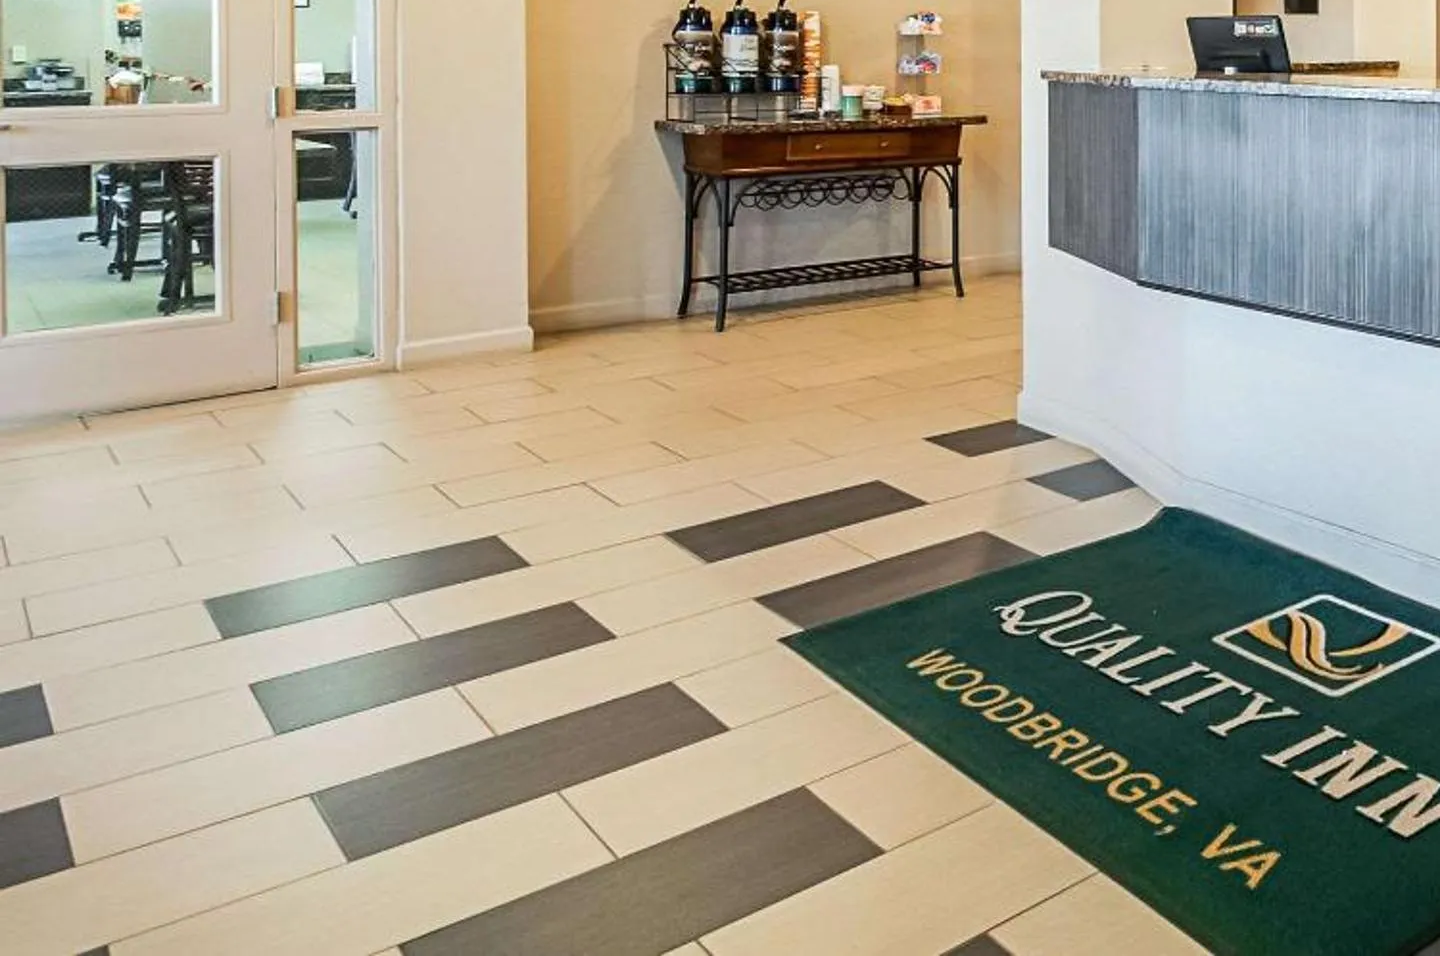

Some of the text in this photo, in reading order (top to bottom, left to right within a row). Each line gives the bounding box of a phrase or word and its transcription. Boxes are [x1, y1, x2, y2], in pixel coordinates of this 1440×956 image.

[993, 590, 1300, 738] QUALITY
[905, 648, 1282, 890] WOODBRIDGE, VA
